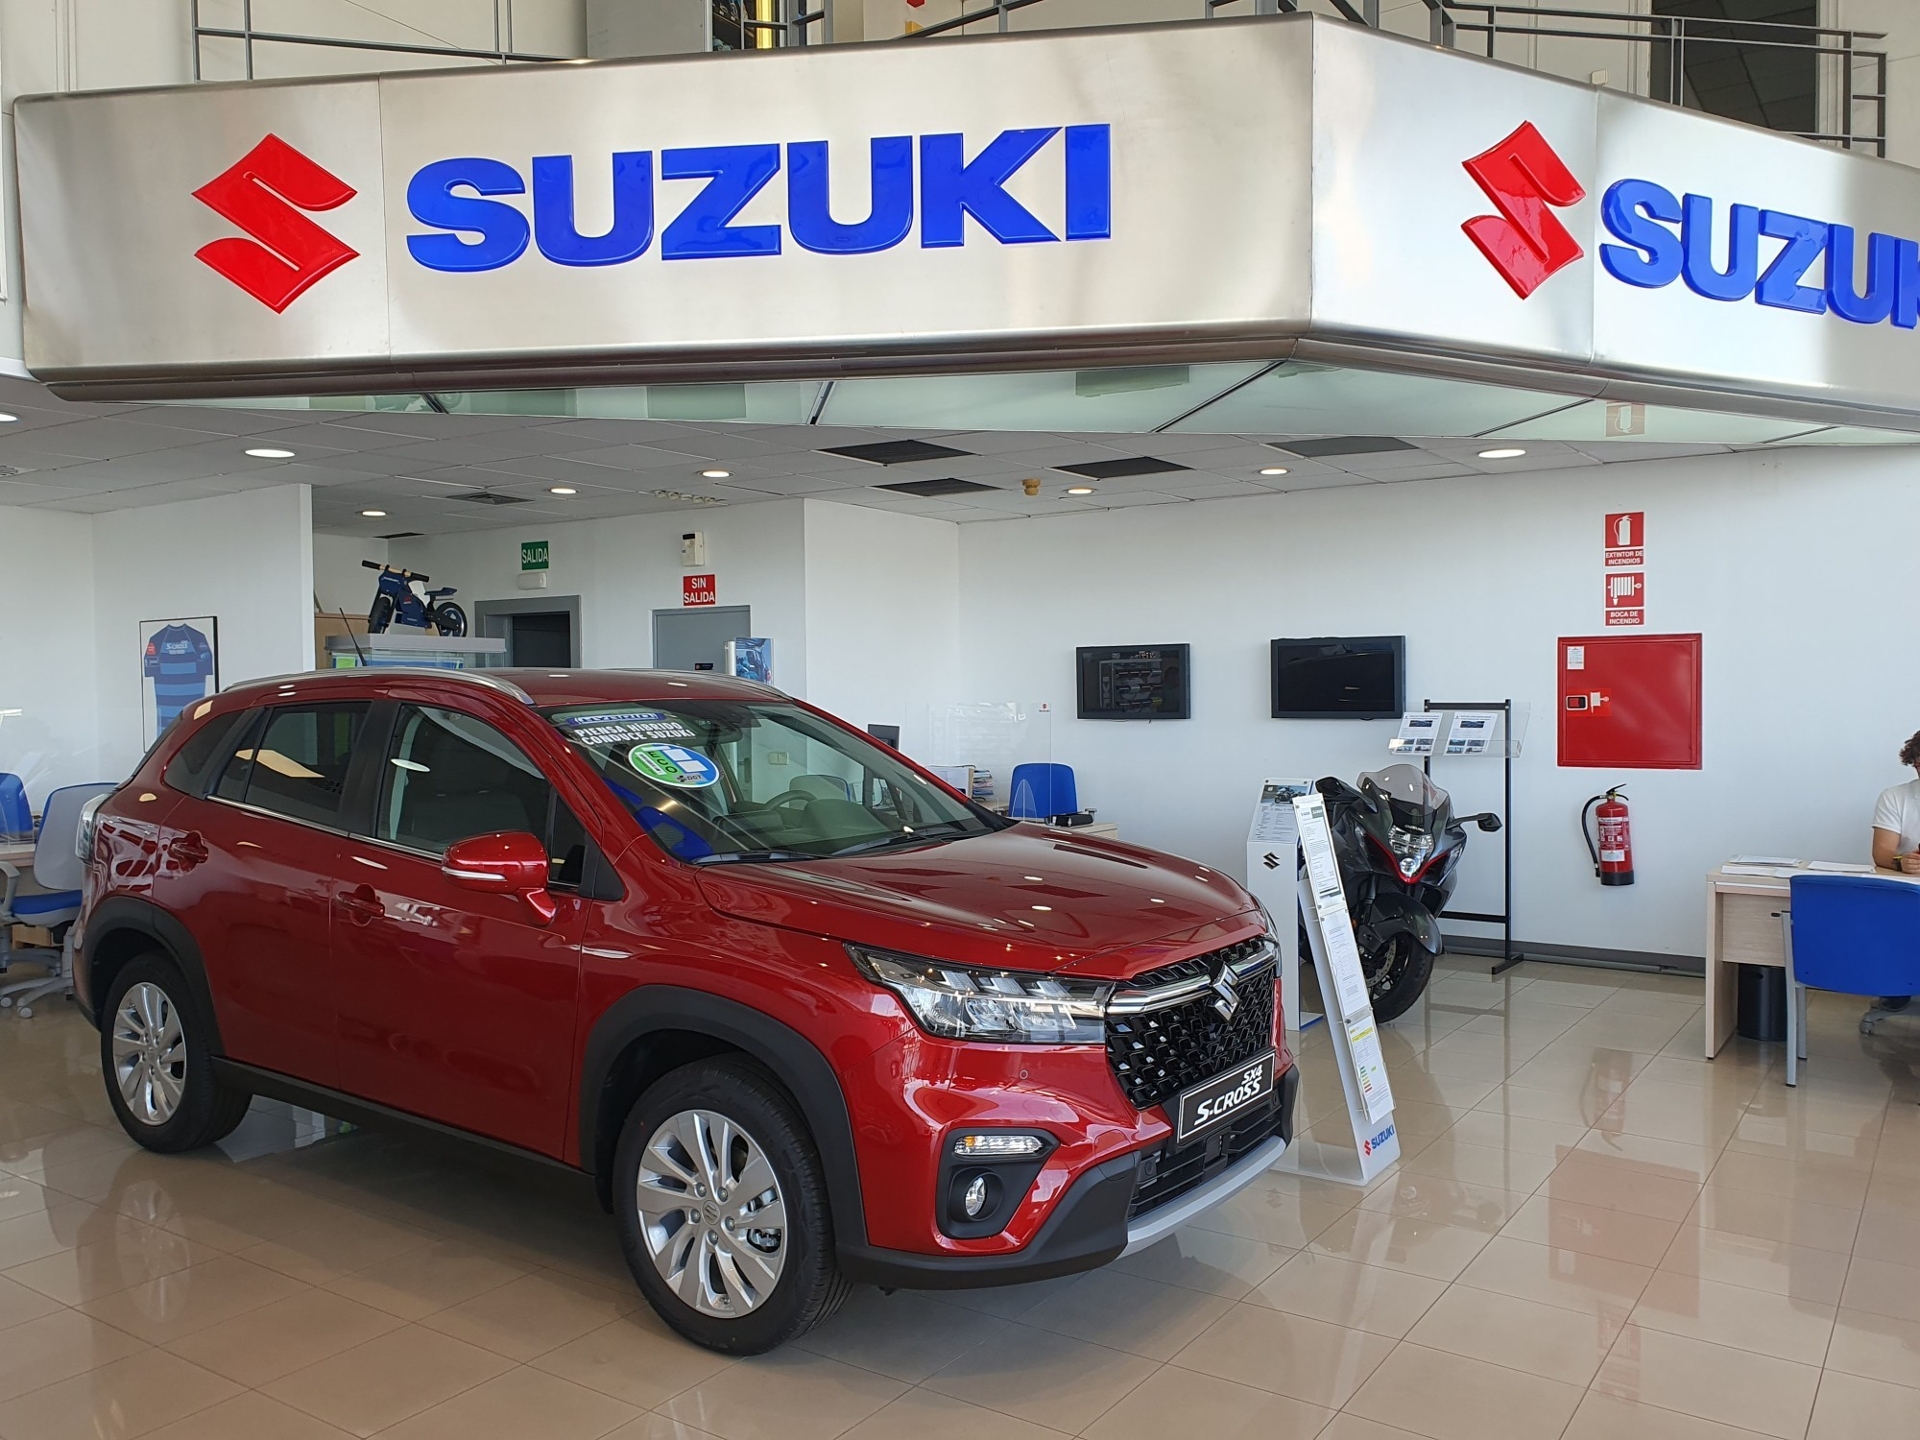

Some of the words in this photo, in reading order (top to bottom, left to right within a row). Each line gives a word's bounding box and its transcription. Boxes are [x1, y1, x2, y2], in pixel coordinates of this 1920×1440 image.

[406, 124, 1111, 272] SUZUKI
[522, 547, 548, 564] SALIDA
[1605, 551, 1634, 559] EXTINTOR
[691, 577, 707, 589] SIN
[684, 591, 715, 604] SALIDA
[574, 725, 628, 737] PIENSA
[627, 722, 683, 732] HÍBRIDO
[581, 732, 648, 745] CONDUCE
[646, 729, 696, 739] SUZUKI
[648, 751, 678, 774] ECO
[1241, 1064, 1263, 1085] SX4
[1193, 1077, 1262, 1126] S-CROSS
[1371, 1124, 1395, 1150] SUZUKI
